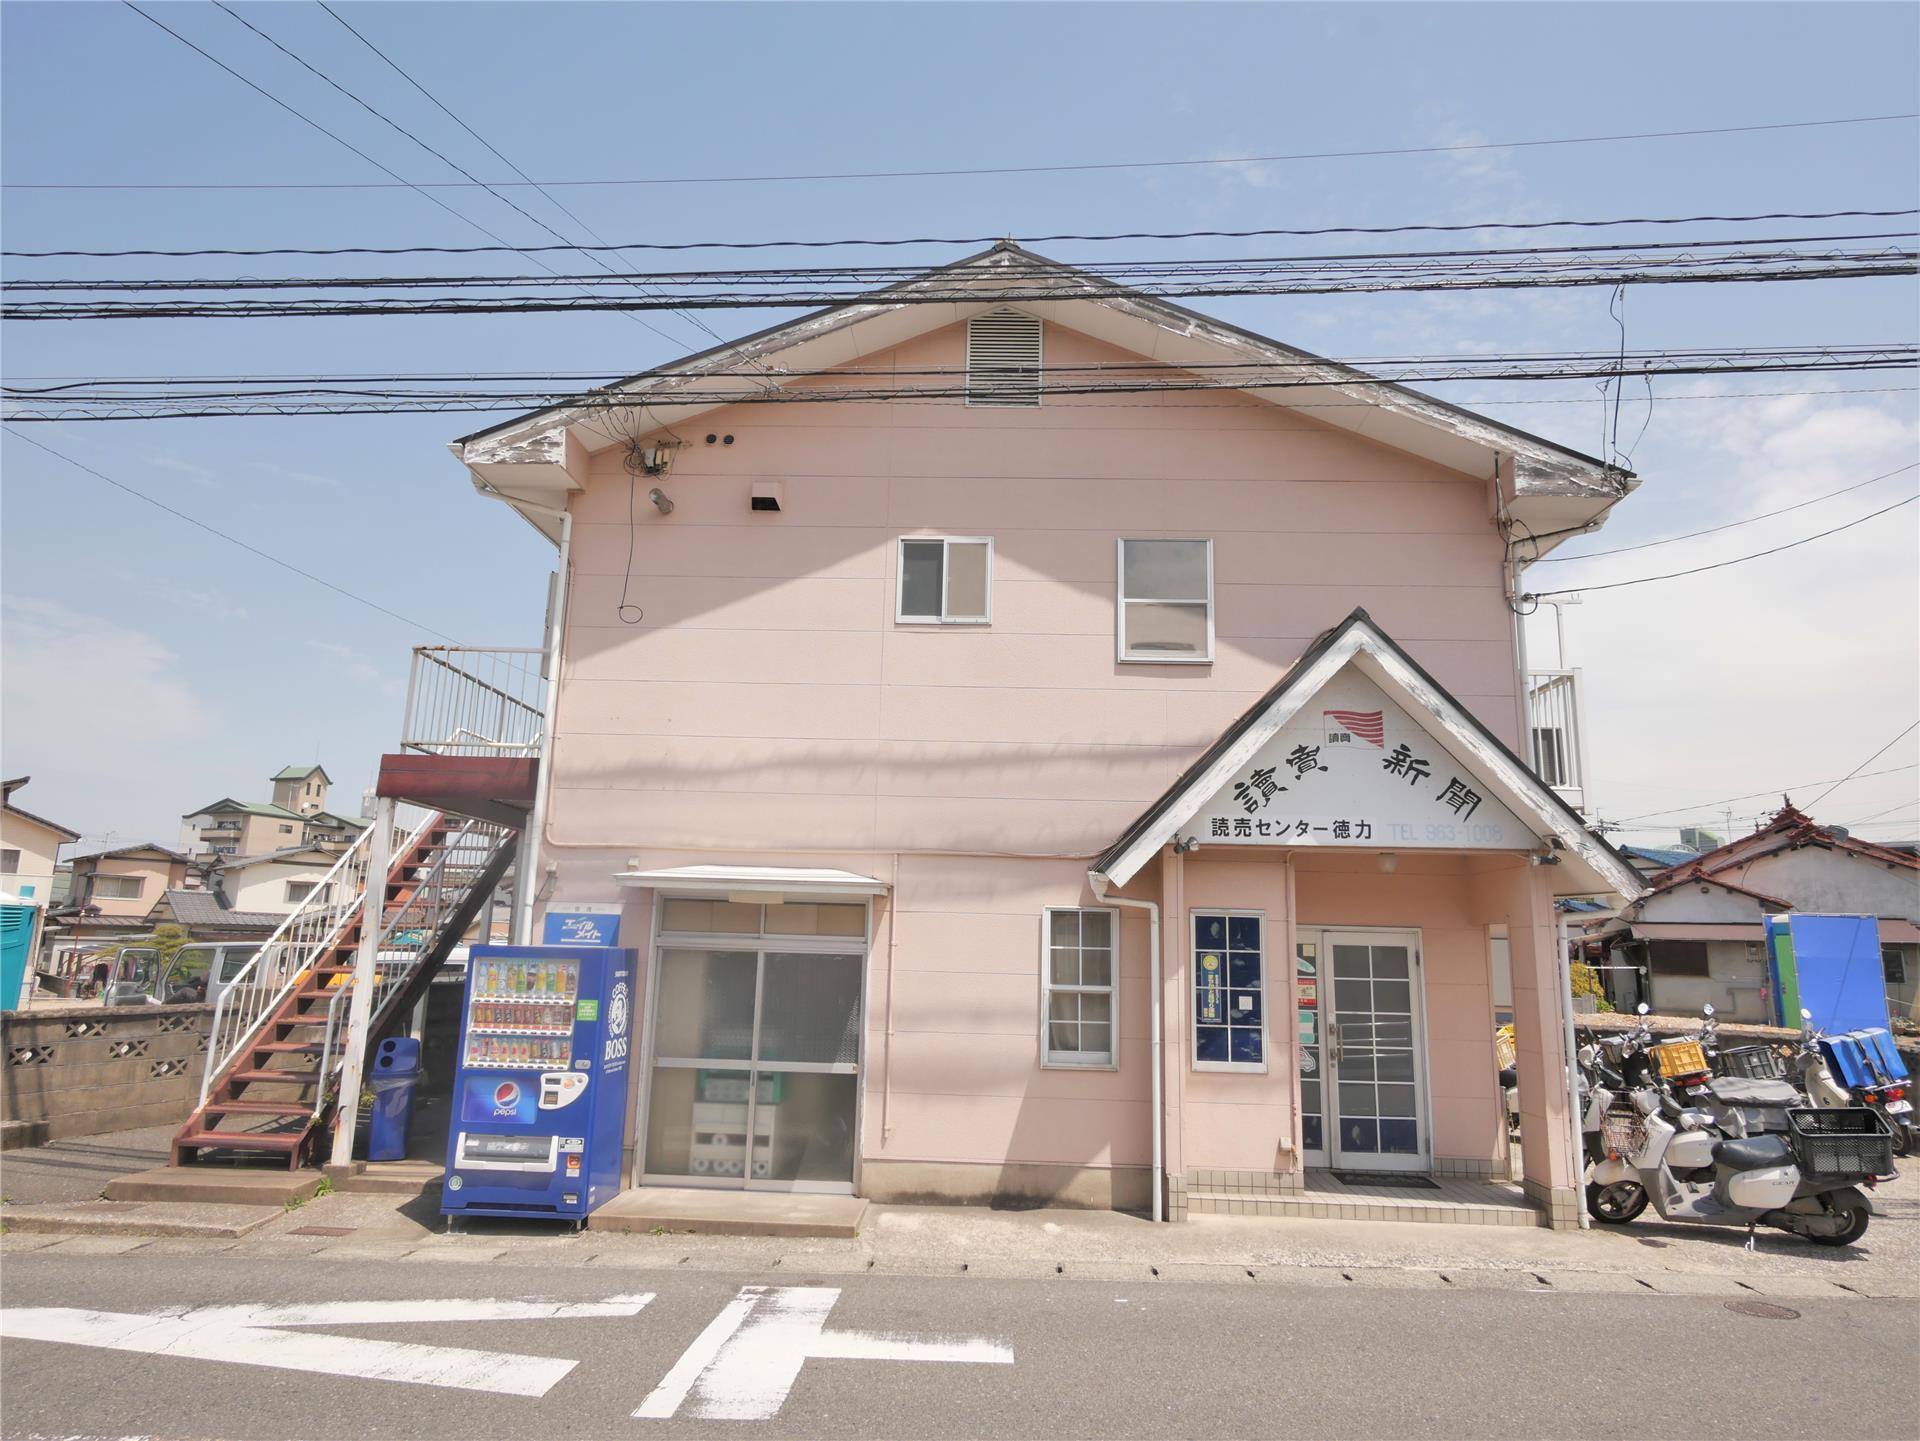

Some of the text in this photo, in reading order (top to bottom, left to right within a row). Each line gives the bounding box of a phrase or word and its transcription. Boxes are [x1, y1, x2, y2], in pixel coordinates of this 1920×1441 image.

[1211, 817, 1372, 840] 読売センター徳力
[1387, 823, 1418, 840] TEL
[604, 1038, 628, 1060] BOSS
[493, 1108, 517, 1117] pepsi
